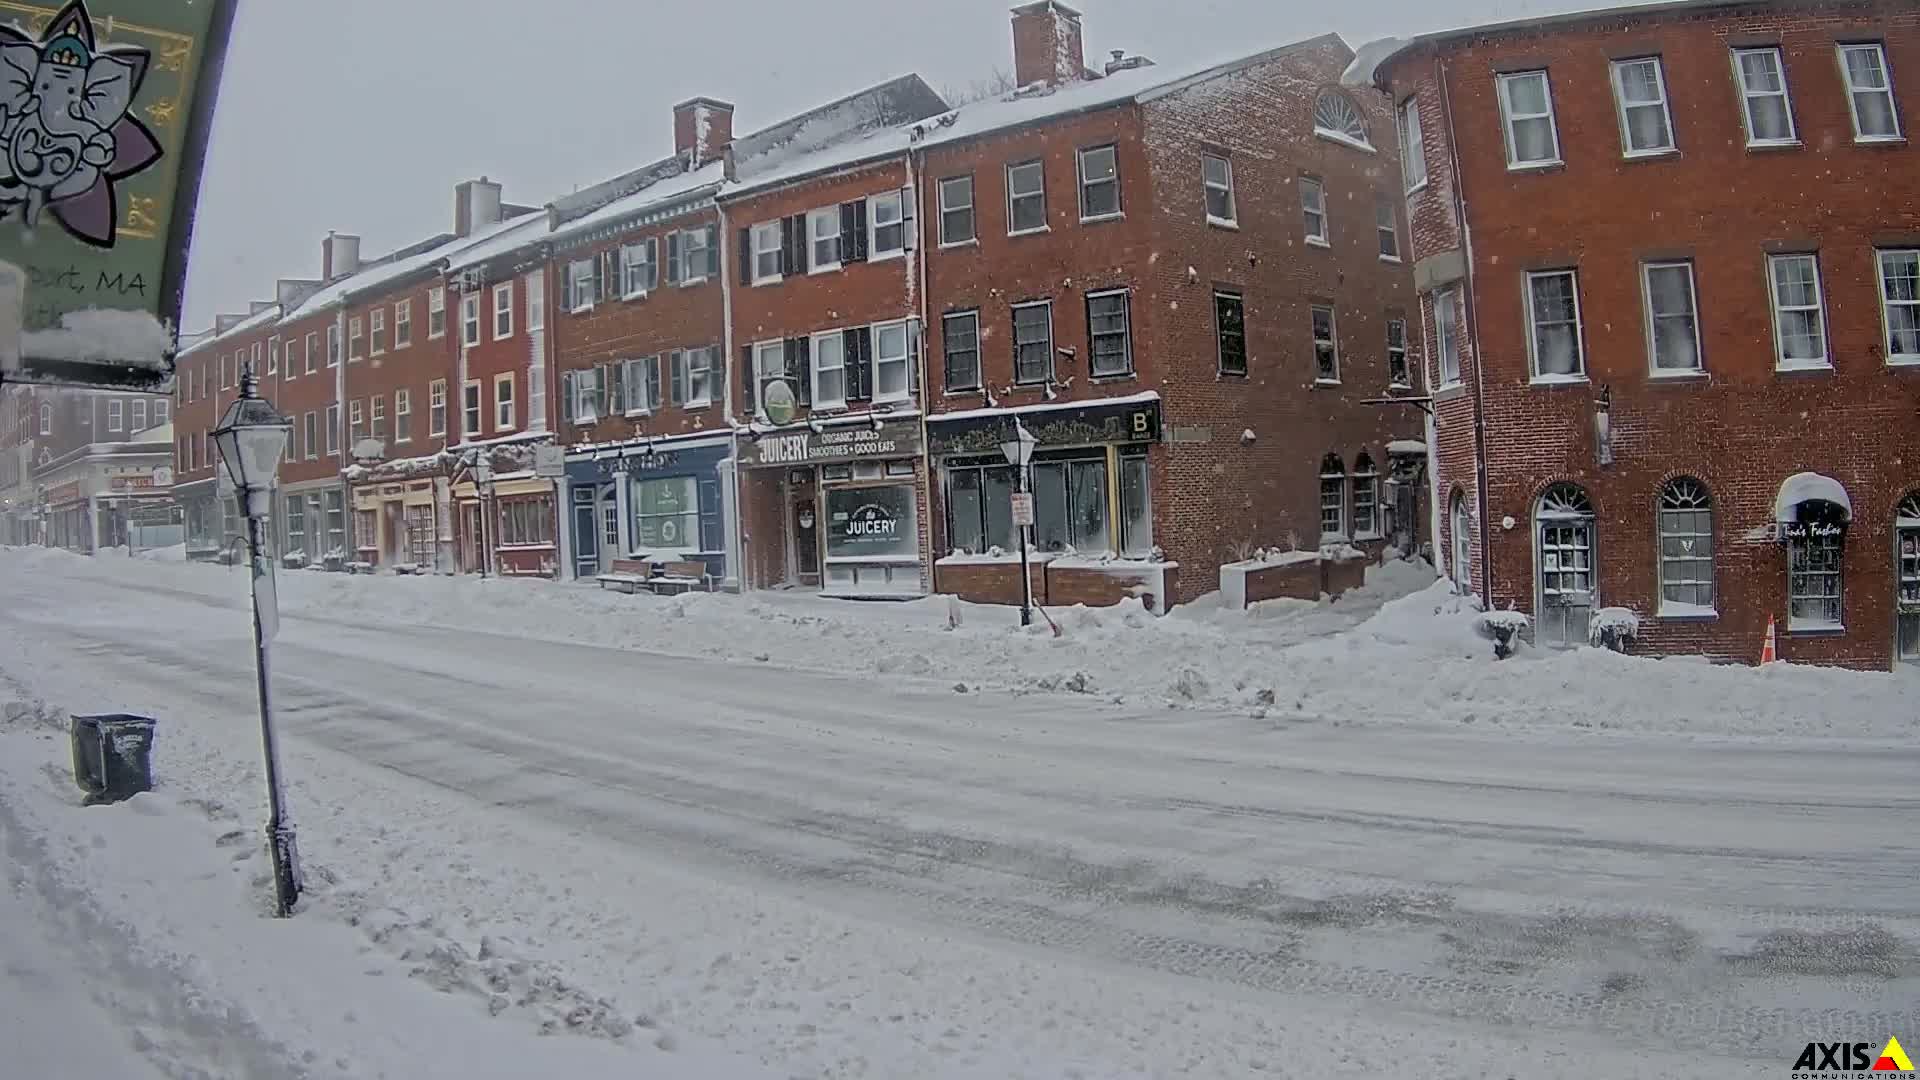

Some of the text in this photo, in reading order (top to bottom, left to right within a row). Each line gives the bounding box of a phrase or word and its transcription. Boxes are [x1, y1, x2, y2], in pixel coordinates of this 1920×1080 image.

[96, 271, 147, 297] MA
[1133, 412, 1148, 432] B
[821, 433, 853, 444] ORGANIC
[760, 434, 809, 463] JUICERY
[808, 440, 896, 458] SMOOTHIES GOOD EATS
[846, 519, 897, 535] JUICERY
